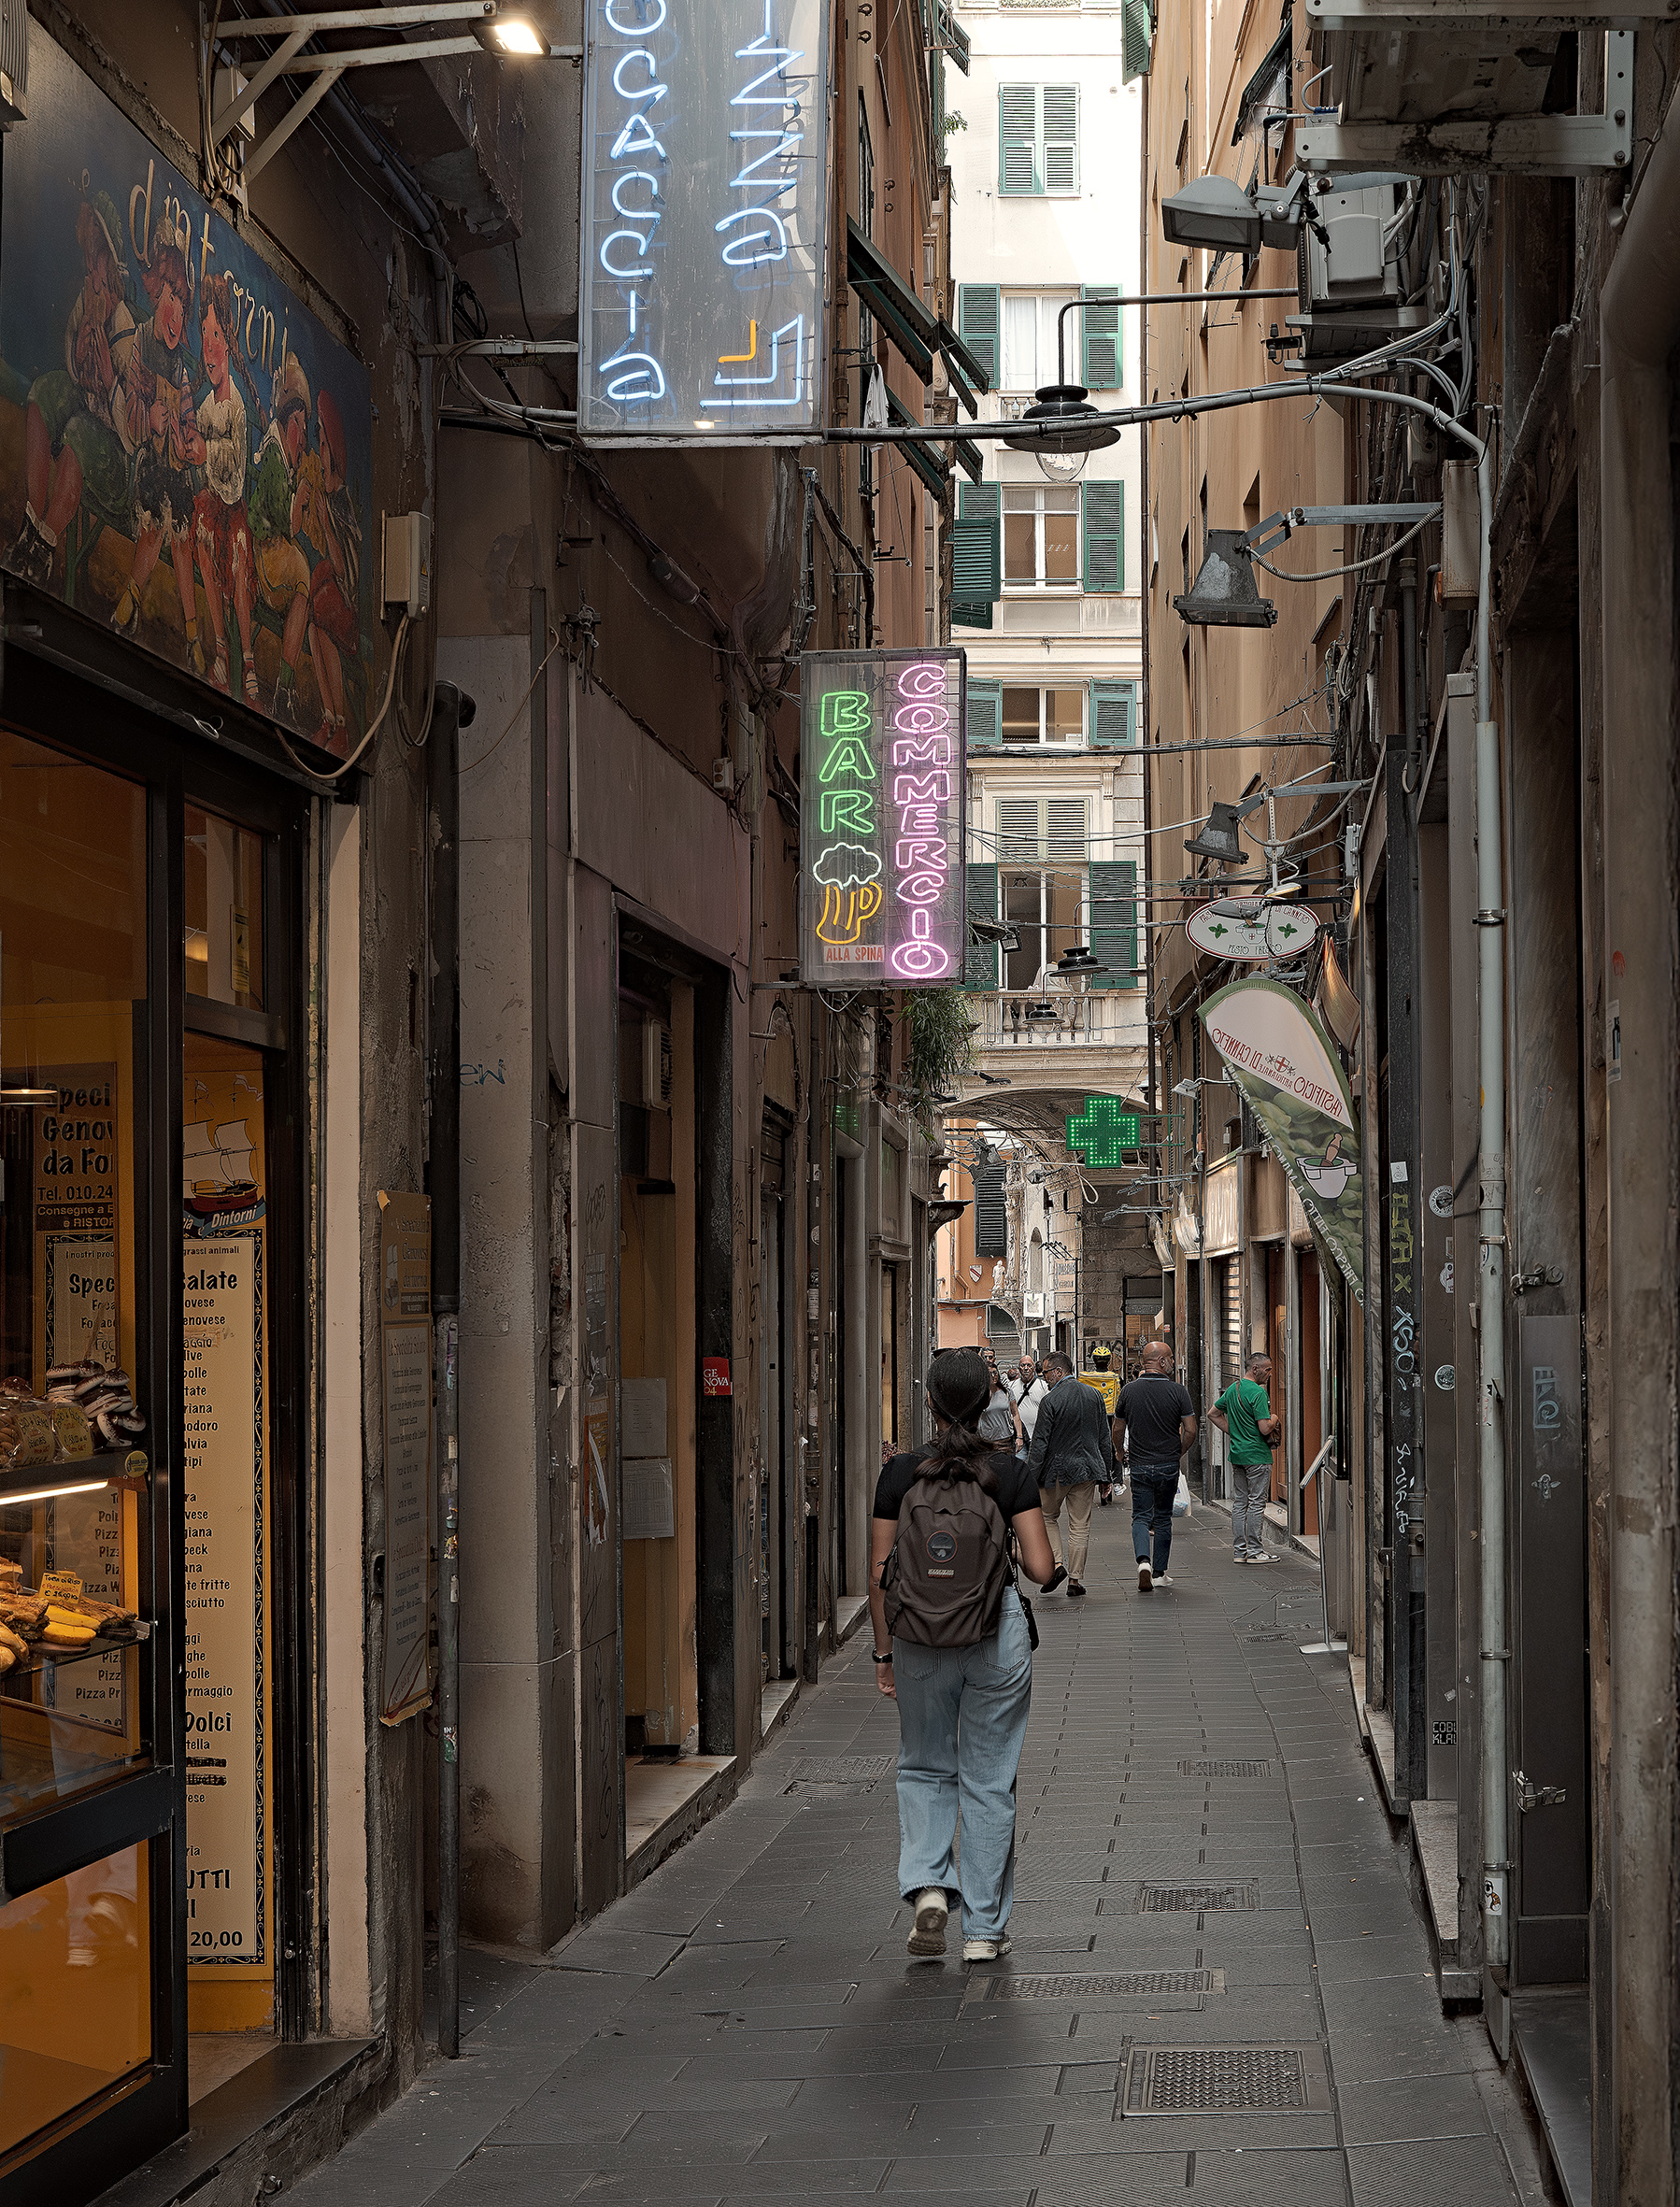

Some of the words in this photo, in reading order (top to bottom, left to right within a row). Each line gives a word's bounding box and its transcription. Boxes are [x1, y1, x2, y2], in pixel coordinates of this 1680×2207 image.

[819, 691, 876, 833] BAR
[891, 663, 951, 978] COMMERCIO
[1283, 906, 1311, 925] CANNETO
[826, 947, 850, 962] ALLA
[855, 946, 884, 962] SPINA
[1227, 944, 1250, 955] PESTO
[43, 1148, 74, 1176] da
[36, 1186, 62, 1202] Tel.
[66, 1185, 114, 1202] 010.24
[37, 1205, 94, 1217] Consegne
[211, 1205, 258, 1229] Dintorni
[208, 1246, 240, 1256] animali
[703, 1368, 719, 1378] GE
[703, 1376, 730, 1387] NOVA
[704, 1386, 718, 1397] 04
[200, 1578, 231, 1590] fritte
[76, 1687, 107, 1700] Pizza
[190, 1930, 243, 1950] 20,00
